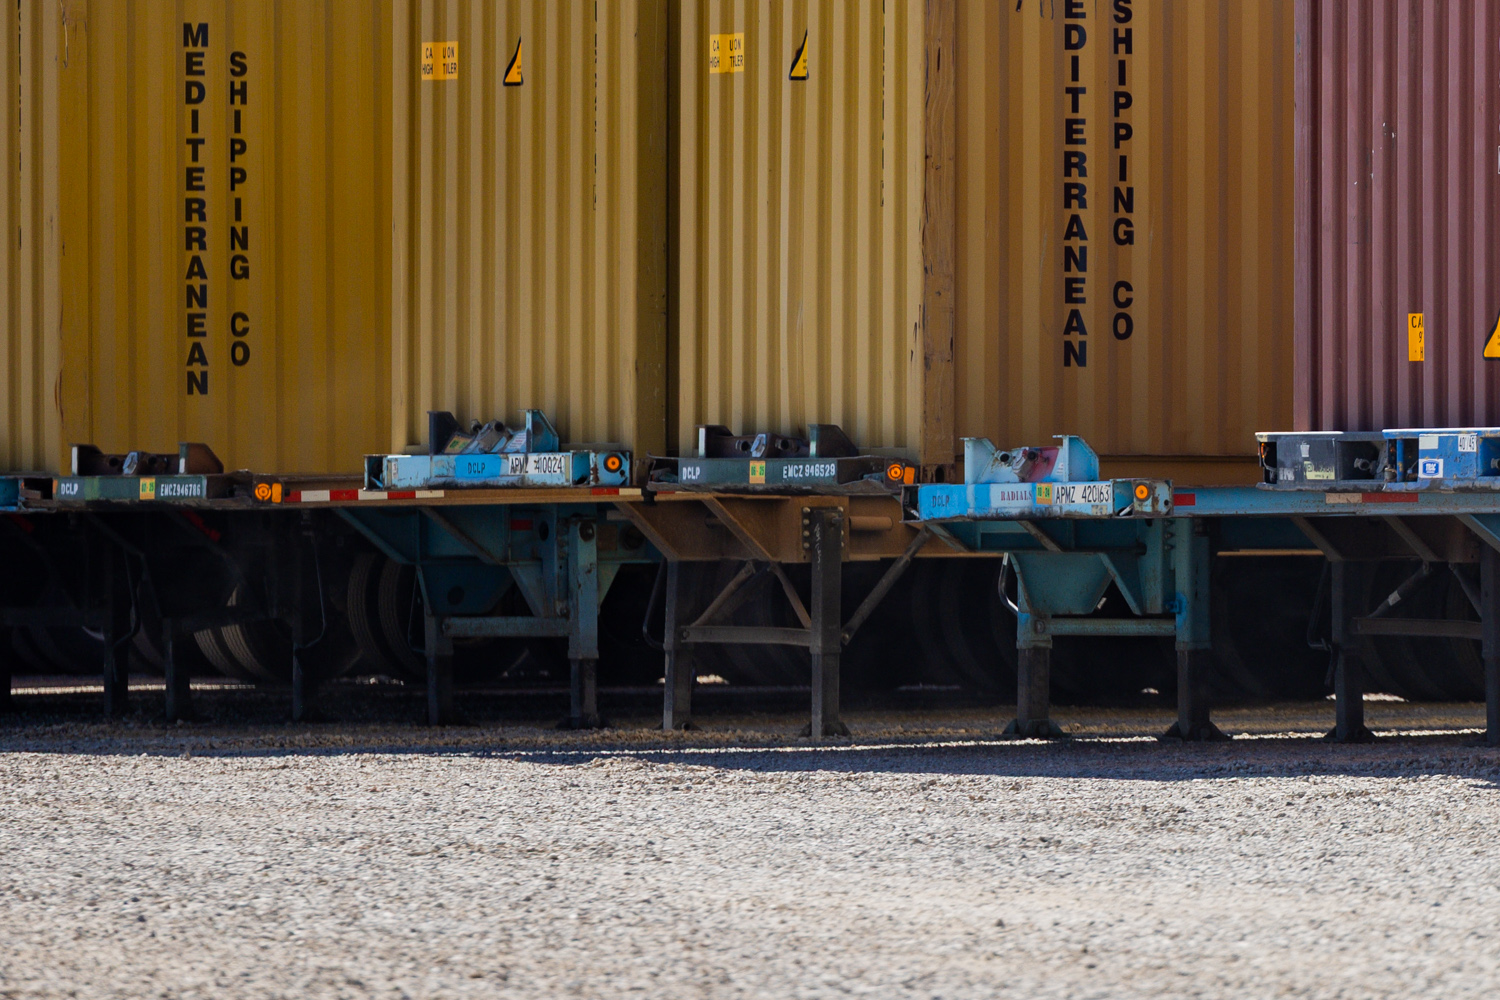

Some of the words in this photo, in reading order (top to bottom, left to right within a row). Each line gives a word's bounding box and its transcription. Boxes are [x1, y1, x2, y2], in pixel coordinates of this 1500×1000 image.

[229, 52, 250, 281] SHIPPING
[183, 23, 209, 396] MEDITERRANEAN
[1113, 281, 1134, 342] CO
[230, 312, 251, 367] CO
[467, 462, 486, 474] DCLP
[682, 466, 701, 480] DCLP
[60, 482, 78, 495] DCLP
[1001, 489, 1033, 502] RADIALS
[1055, 486, 1076, 504] APMZ
[932, 495, 950, 508] DCLP
